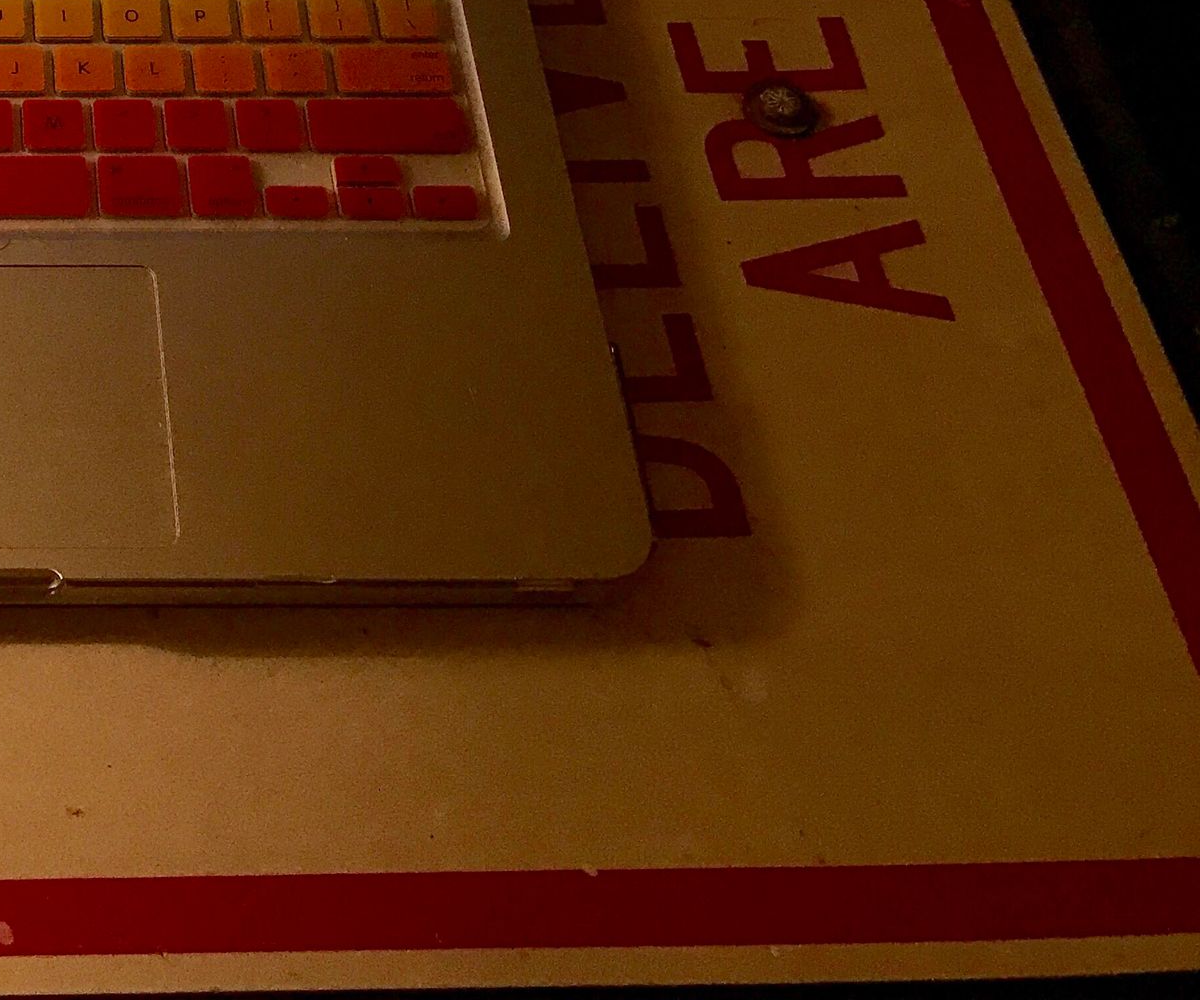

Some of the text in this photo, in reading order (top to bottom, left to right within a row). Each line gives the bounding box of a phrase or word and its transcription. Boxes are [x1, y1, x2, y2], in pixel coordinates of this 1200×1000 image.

[62, 9, 66, 22] I
[124, 9, 139, 22] O
[195, 9, 206, 22] P
[10, 62, 19, 76] J
[78, 62, 90, 76] K
[150, 62, 160, 76] L
